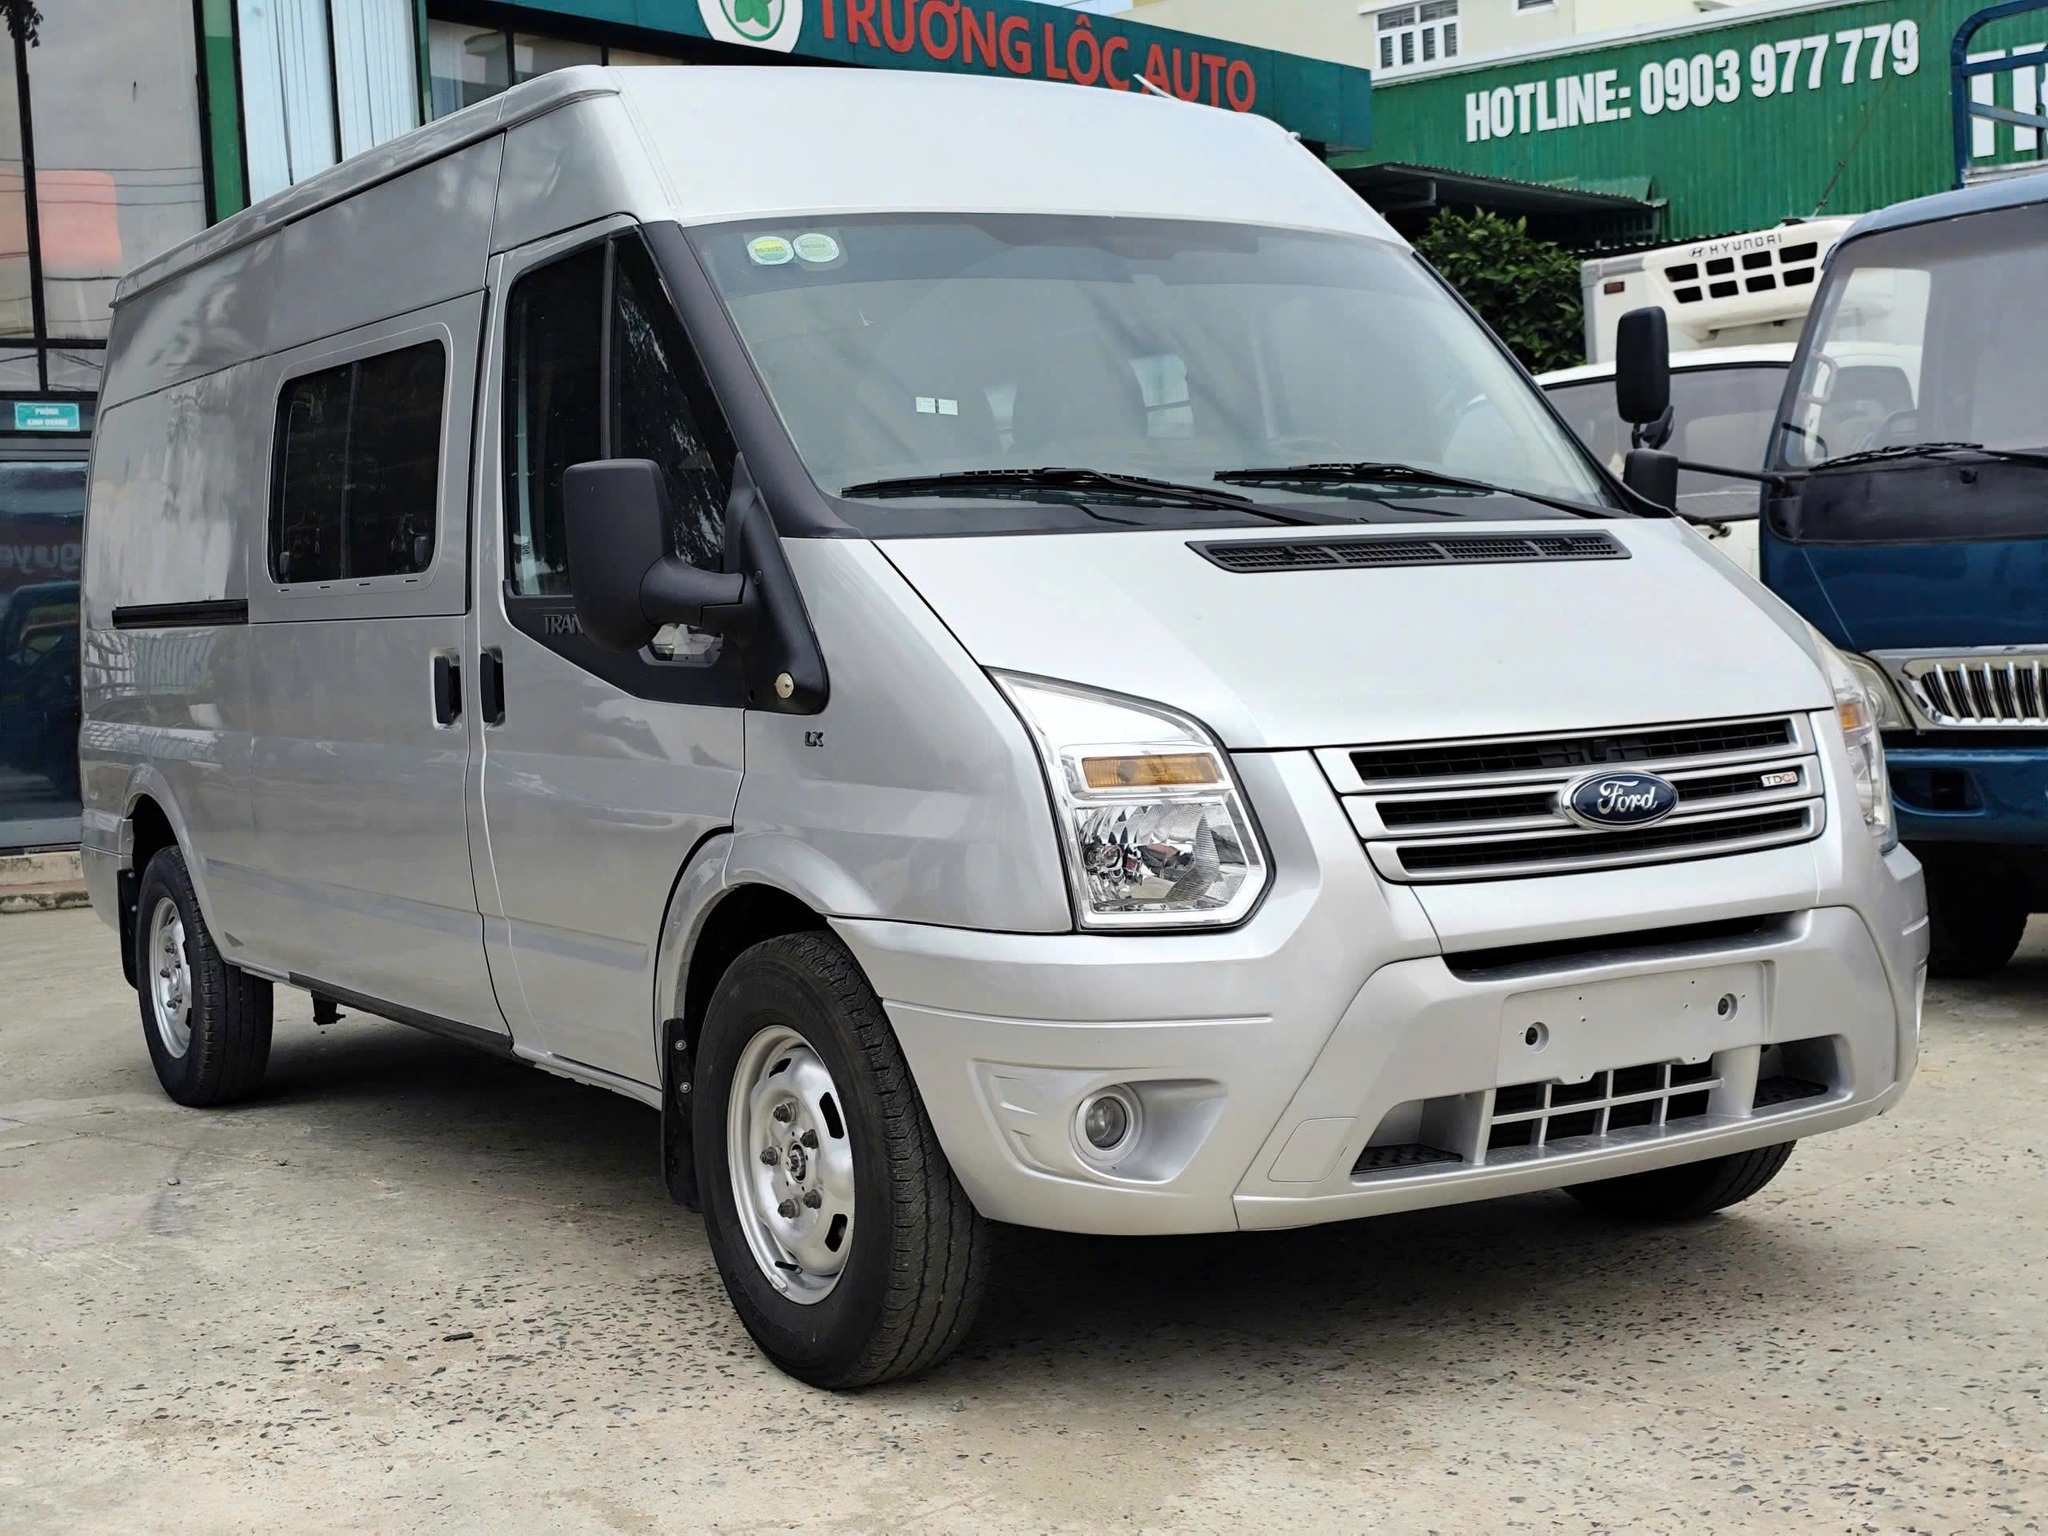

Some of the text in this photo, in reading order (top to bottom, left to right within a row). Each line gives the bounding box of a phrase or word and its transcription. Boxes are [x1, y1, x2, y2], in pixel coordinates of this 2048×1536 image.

[1141, 43, 1256, 113] AUTO
[1466, 19, 1920, 143] HOTLINE: 0903 977 779
[1709, 234, 1782, 256] HYUNDAI
[1763, 772, 1797, 785] TDCi
[1597, 779, 1658, 815] Ford
